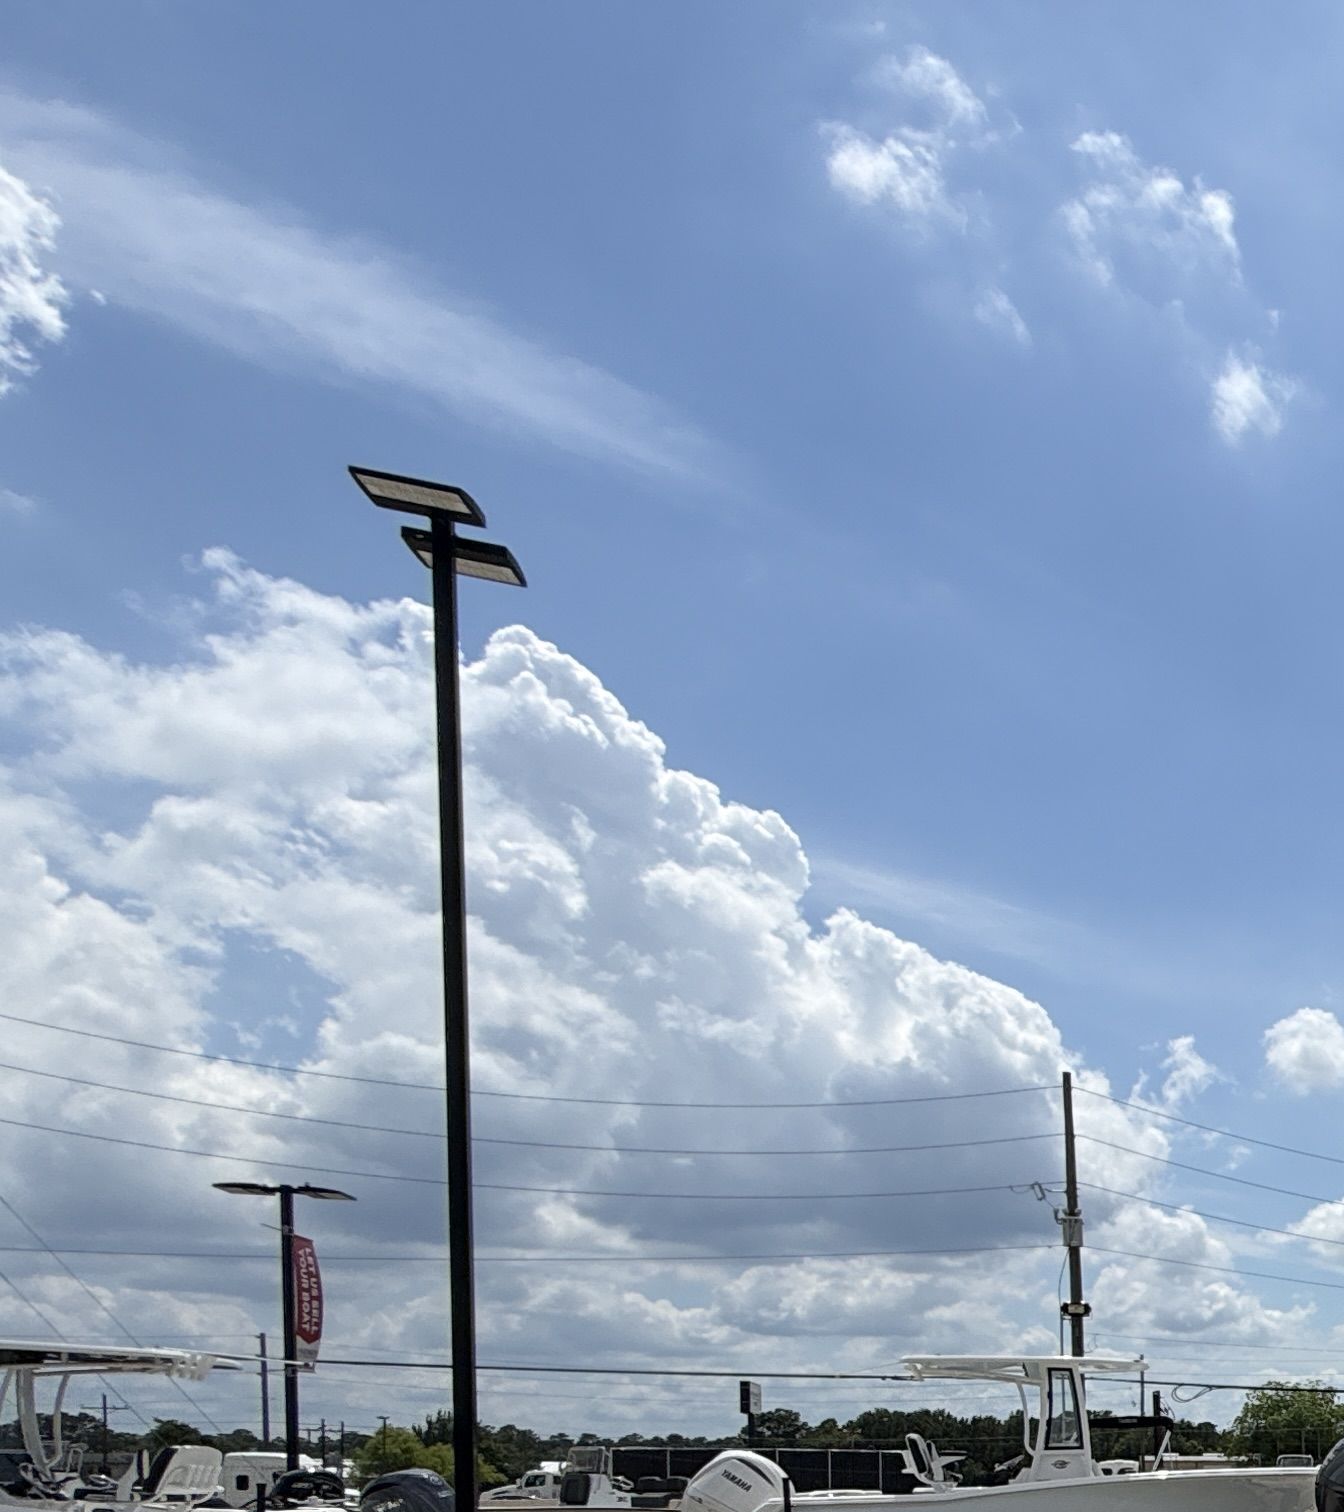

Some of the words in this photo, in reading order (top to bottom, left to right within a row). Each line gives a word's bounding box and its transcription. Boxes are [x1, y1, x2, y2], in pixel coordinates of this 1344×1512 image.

[298, 1248, 309, 1288] YOUR
[310, 1277, 319, 1298] US
[301, 1294, 311, 1332] BOAT
[311, 1300, 319, 1334] SELL
[721, 1468, 753, 1493] YAMAHA
